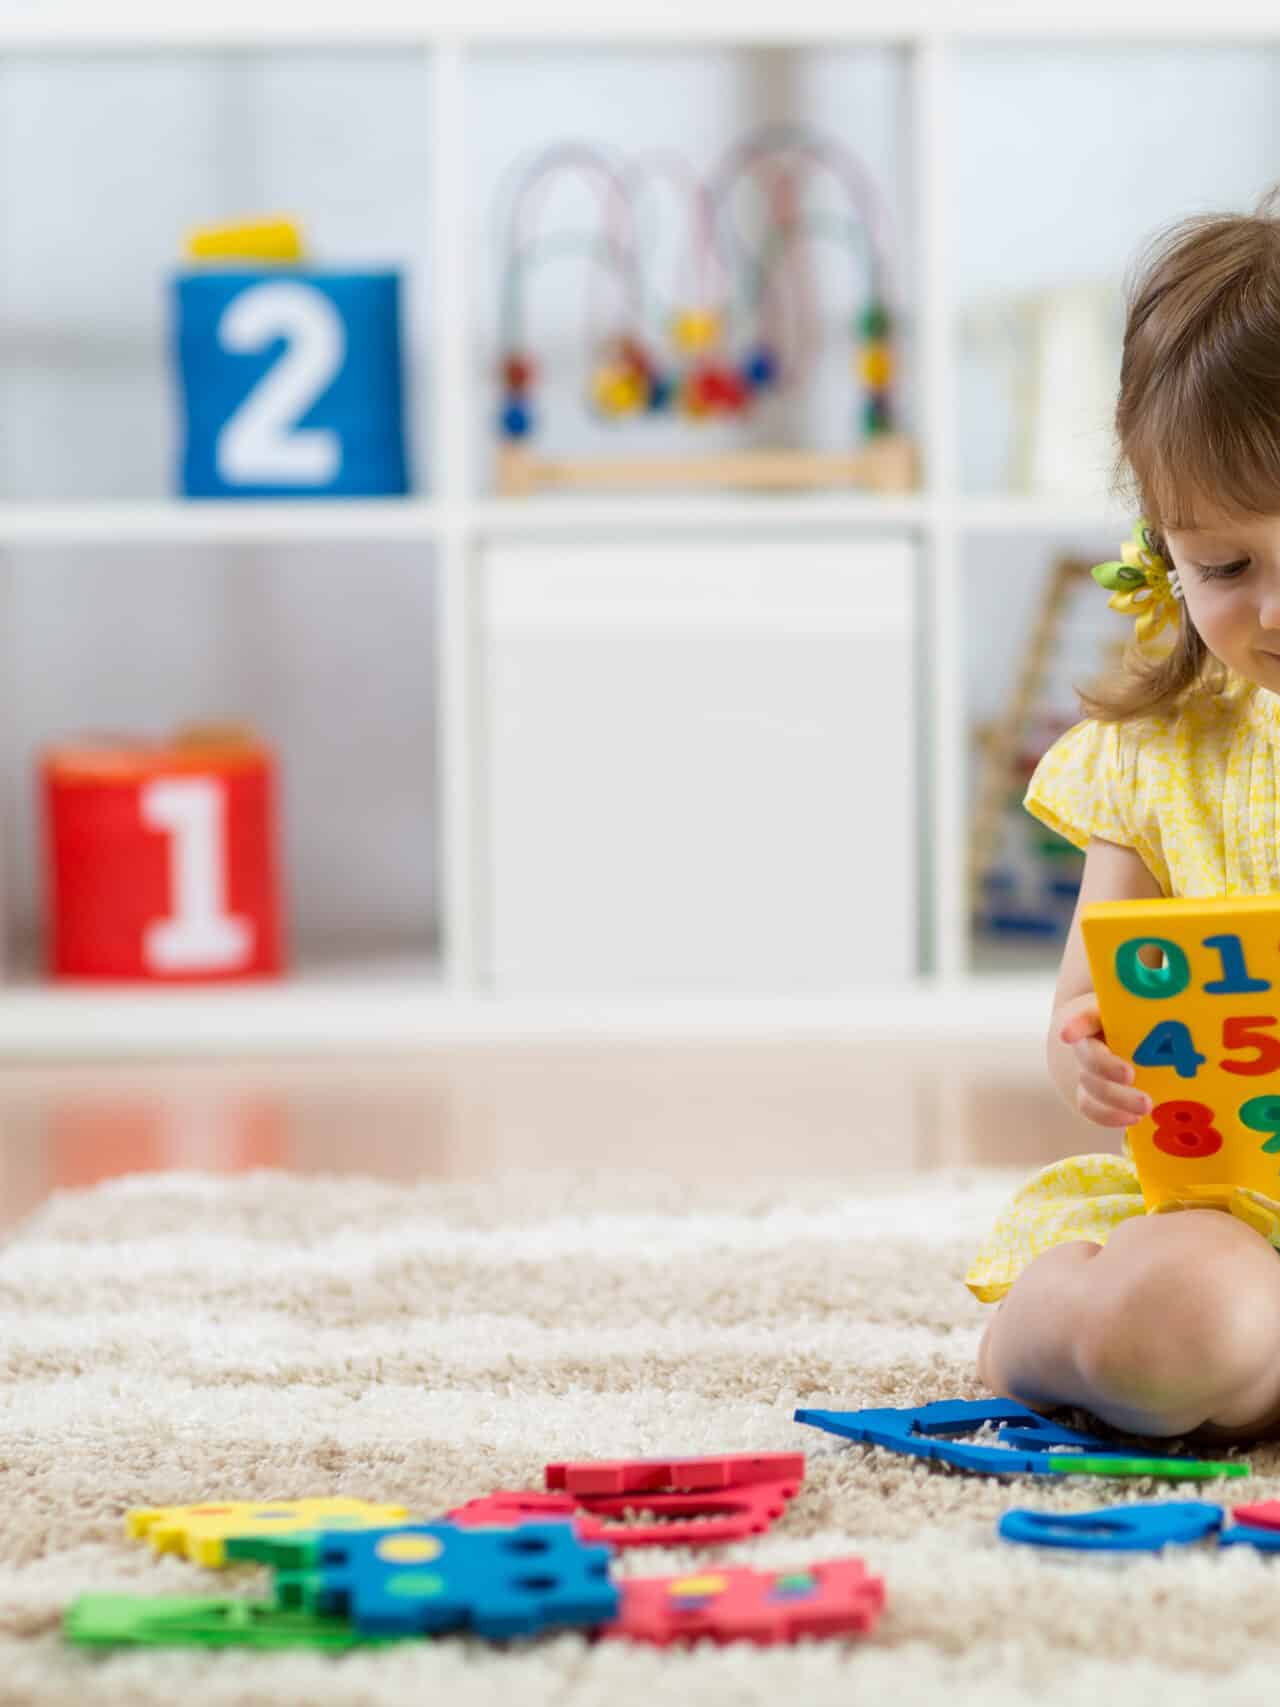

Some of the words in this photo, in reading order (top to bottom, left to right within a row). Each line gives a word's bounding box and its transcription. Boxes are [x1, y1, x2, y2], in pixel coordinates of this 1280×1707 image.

[216, 280, 346, 486] 2
[141, 779, 254, 972] 1
[1115, 937, 1190, 998] 0
[1202, 934, 1271, 995] 1
[1132, 1020, 1206, 1078] 4
[1151, 1100, 1223, 1158] 8
